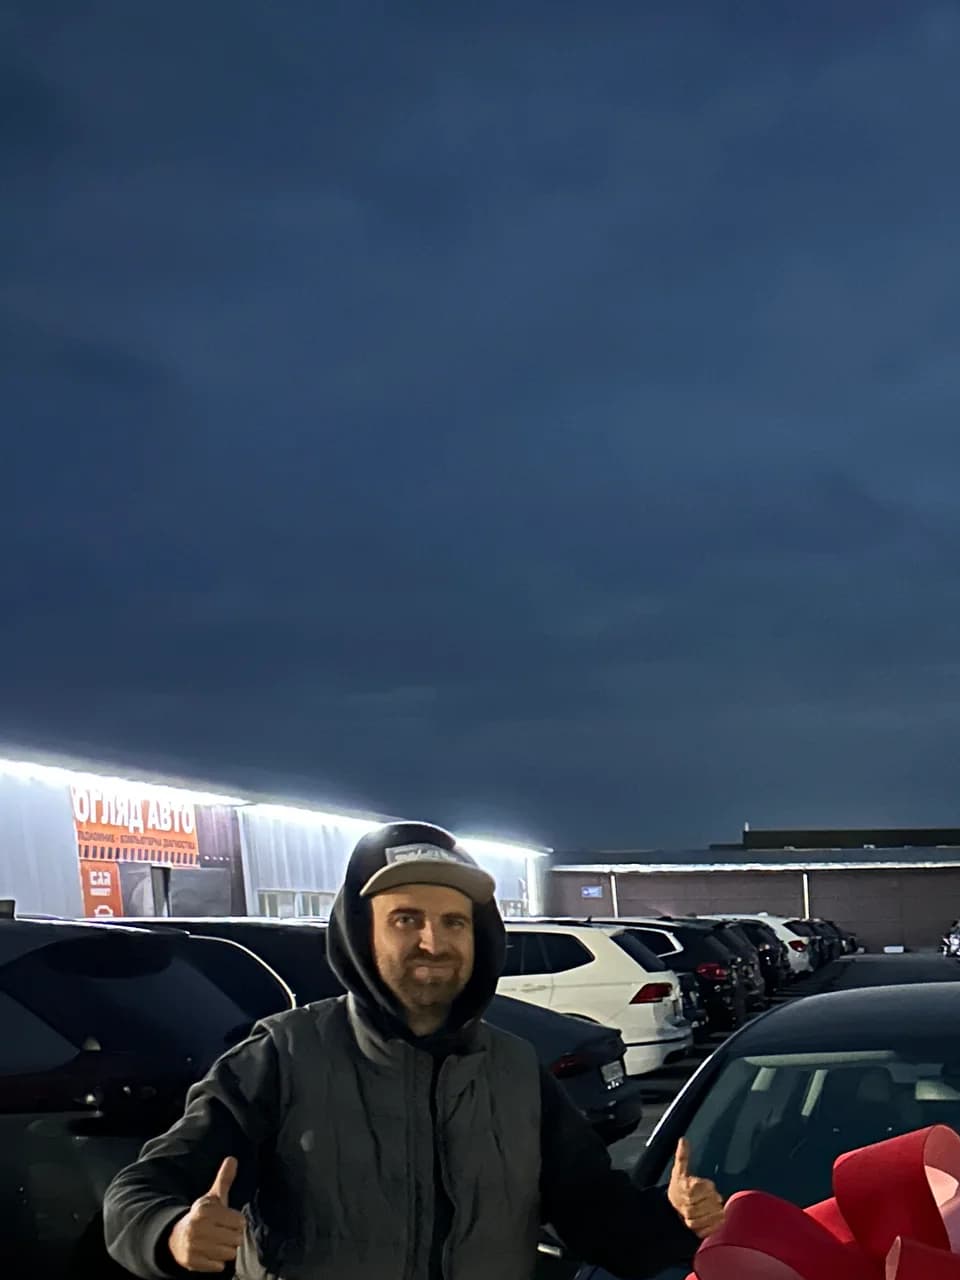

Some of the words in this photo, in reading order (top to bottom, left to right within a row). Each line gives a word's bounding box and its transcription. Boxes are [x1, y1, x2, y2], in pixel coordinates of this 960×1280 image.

[74, 789, 144, 833] ОГЛЯД
[147, 798, 194, 834] АВТО
[89, 871, 112, 886] CAR
